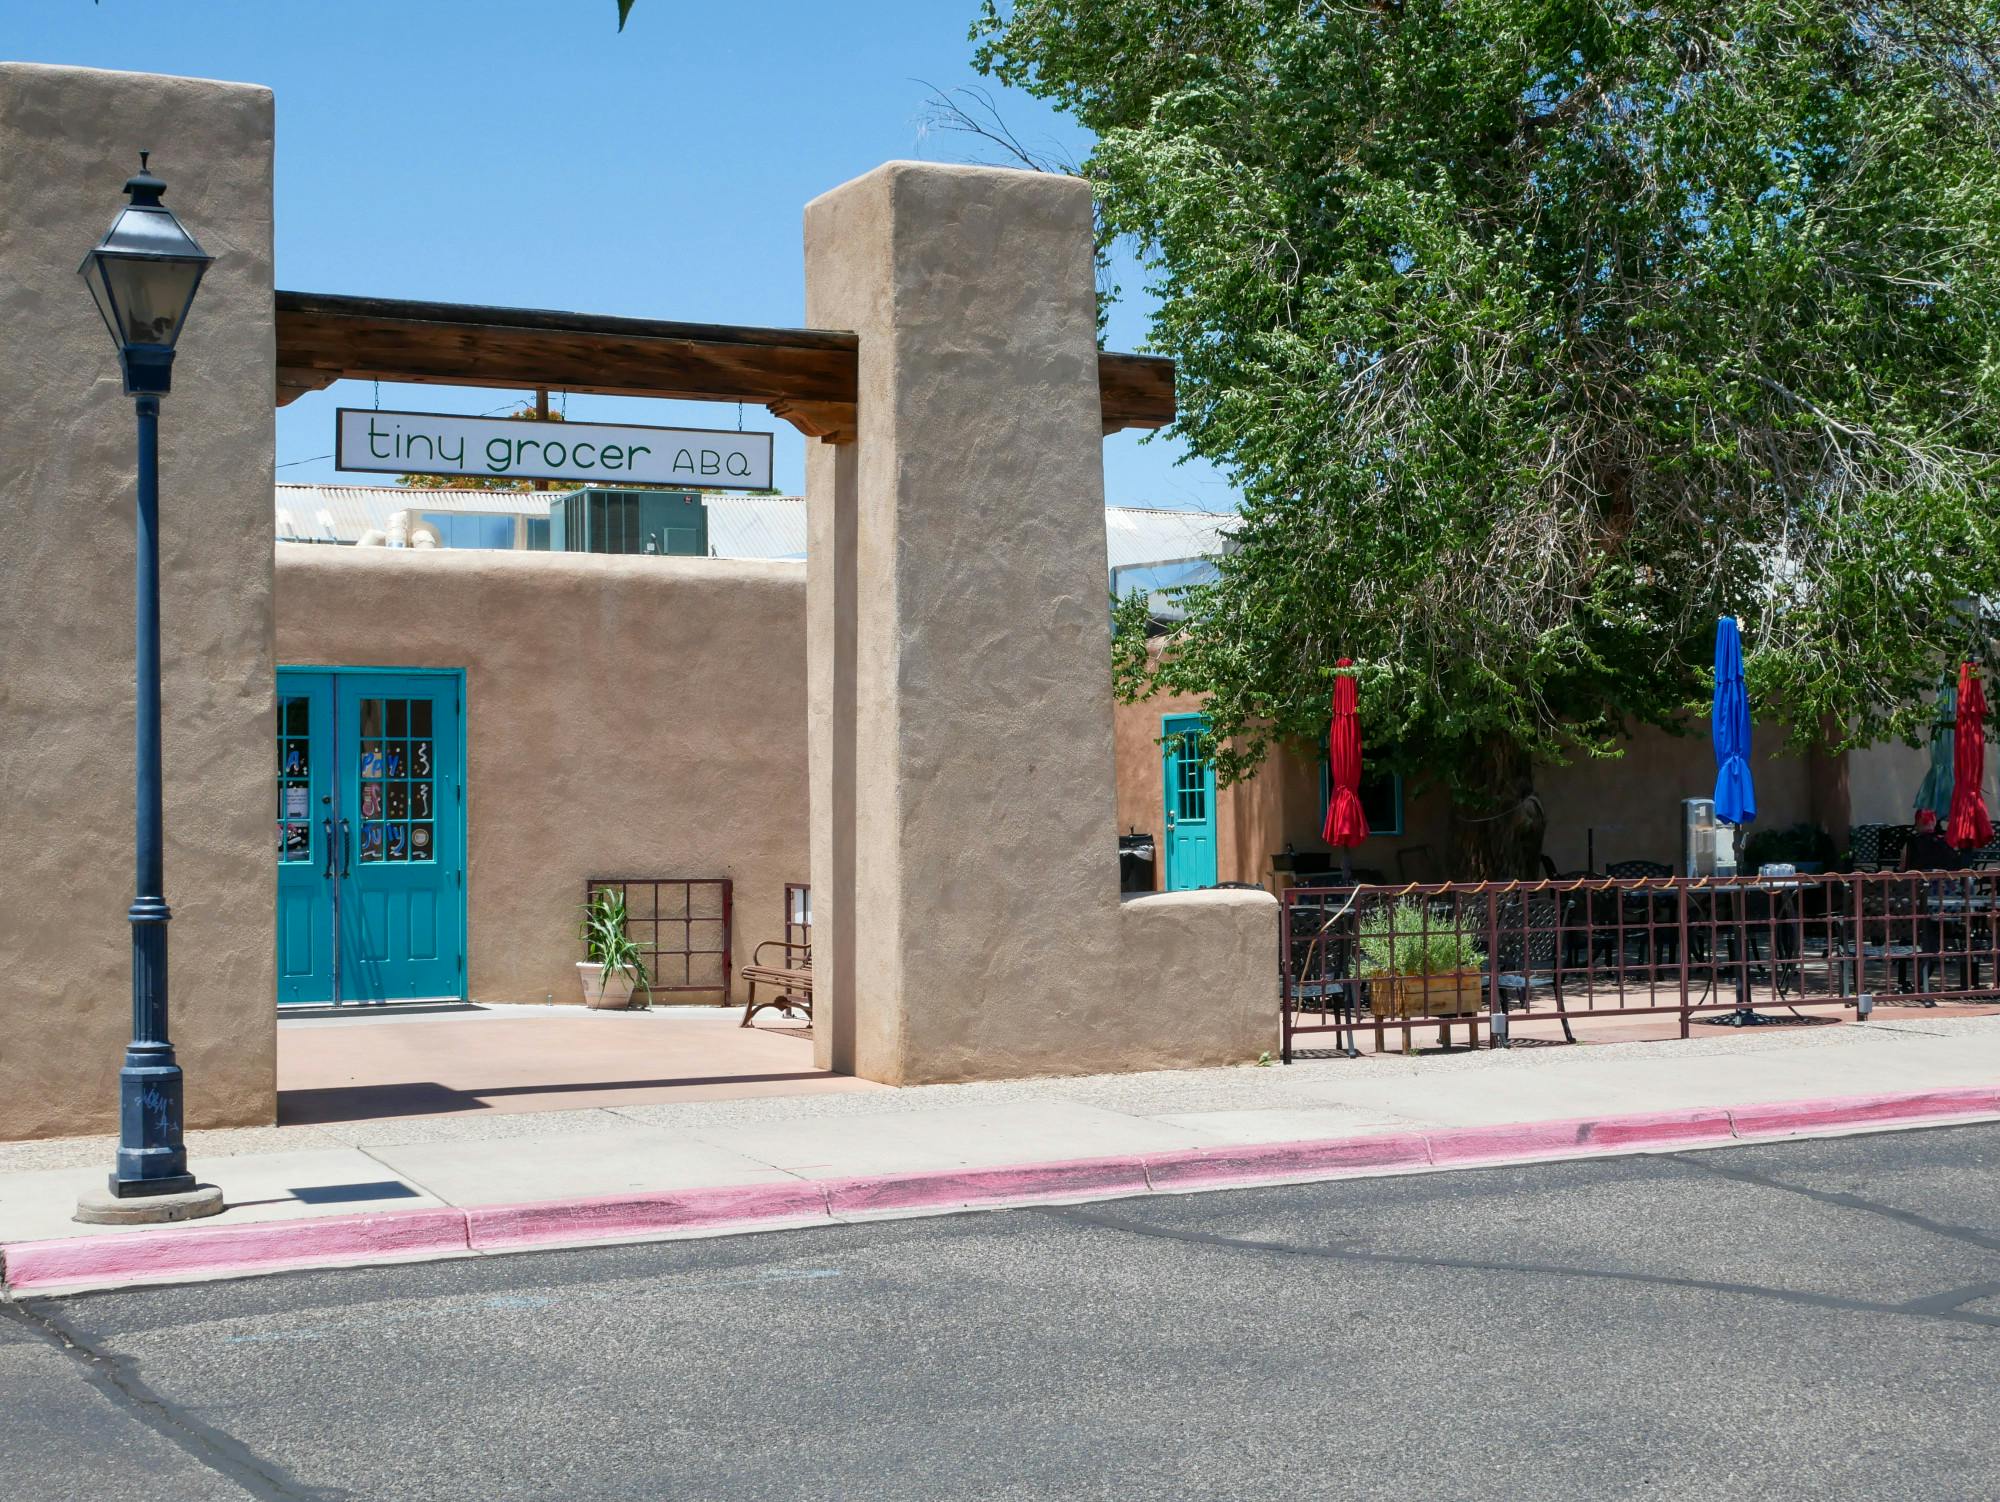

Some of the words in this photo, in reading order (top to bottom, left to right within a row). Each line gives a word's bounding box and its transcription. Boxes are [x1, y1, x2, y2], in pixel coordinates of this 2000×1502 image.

[367, 417, 465, 470] tiny
[486, 437, 652, 473] grocer
[672, 448, 752, 477] ABQ
